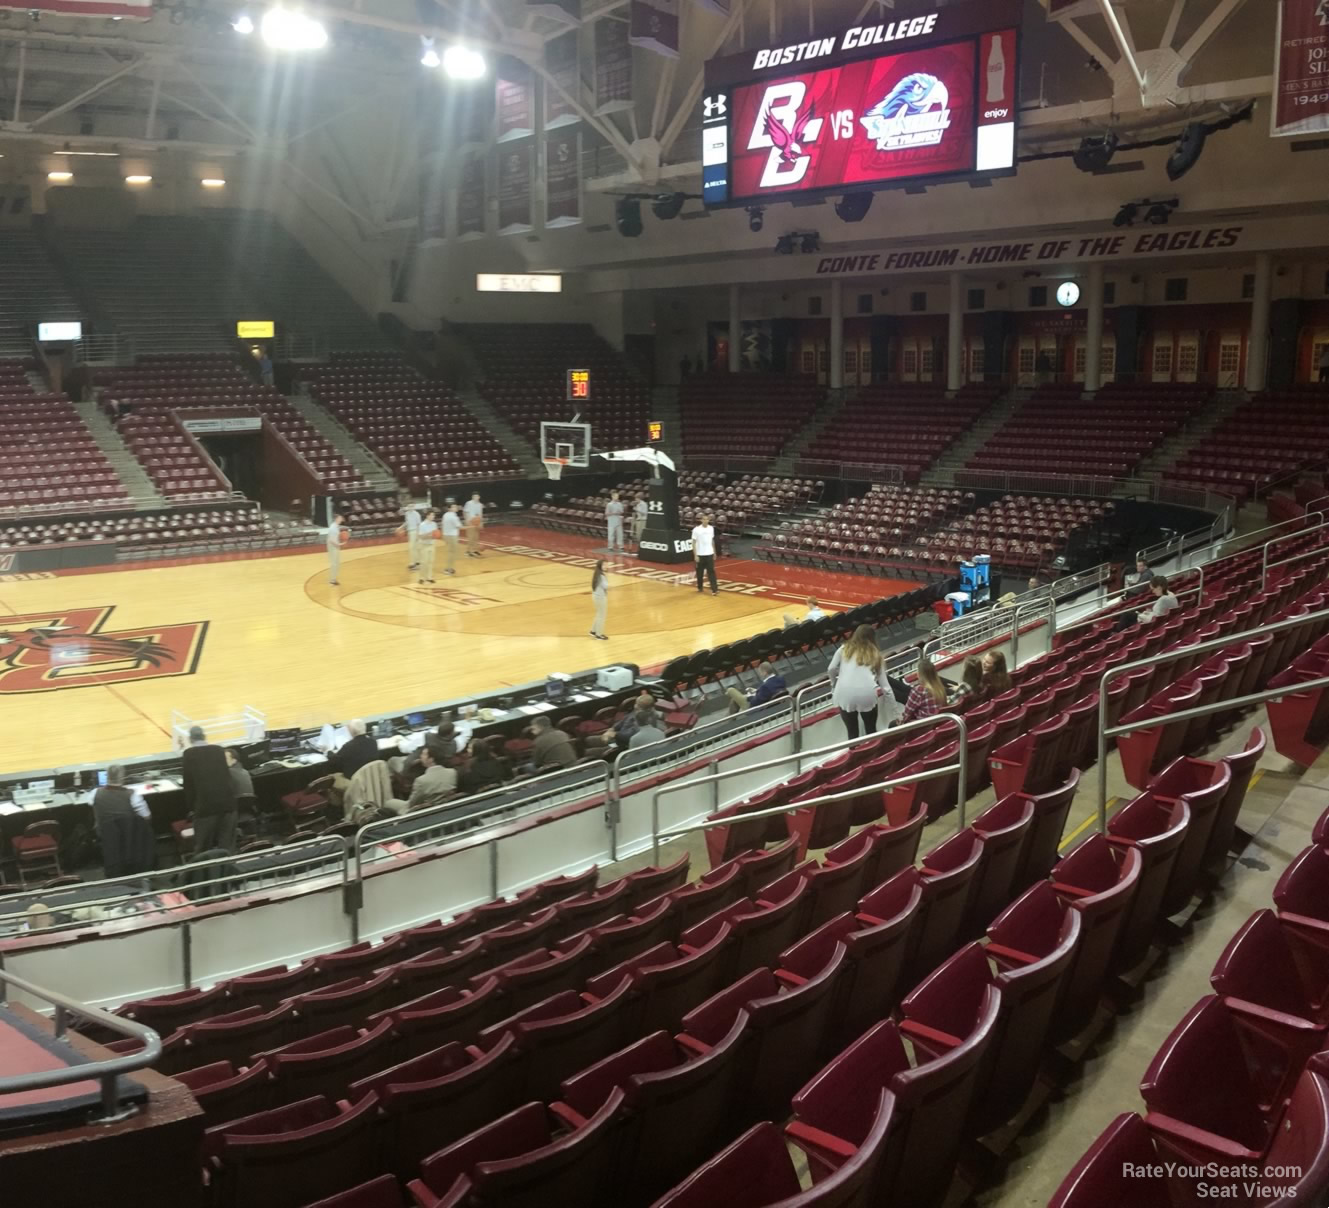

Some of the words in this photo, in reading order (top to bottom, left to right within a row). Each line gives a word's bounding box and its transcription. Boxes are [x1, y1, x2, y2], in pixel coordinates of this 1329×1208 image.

[753, 38, 836, 70] BOSTON
[841, 14, 938, 50] COLLEGE
[1283, 36, 1327, 48] RETIRED
[984, 108, 1008, 118] enjoy
[831, 109, 854, 141] VS
[816, 253, 880, 274] CONTE
[884, 248, 955, 270] FORUM
[967, 243, 1033, 265] HOME
[1039, 241, 1071, 260] OF
[1077, 236, 1126, 256] THE
[1133, 227, 1243, 253] EAGLES
[572, 381, 588, 396] 30
[640, 541, 668, 551] GEICO
